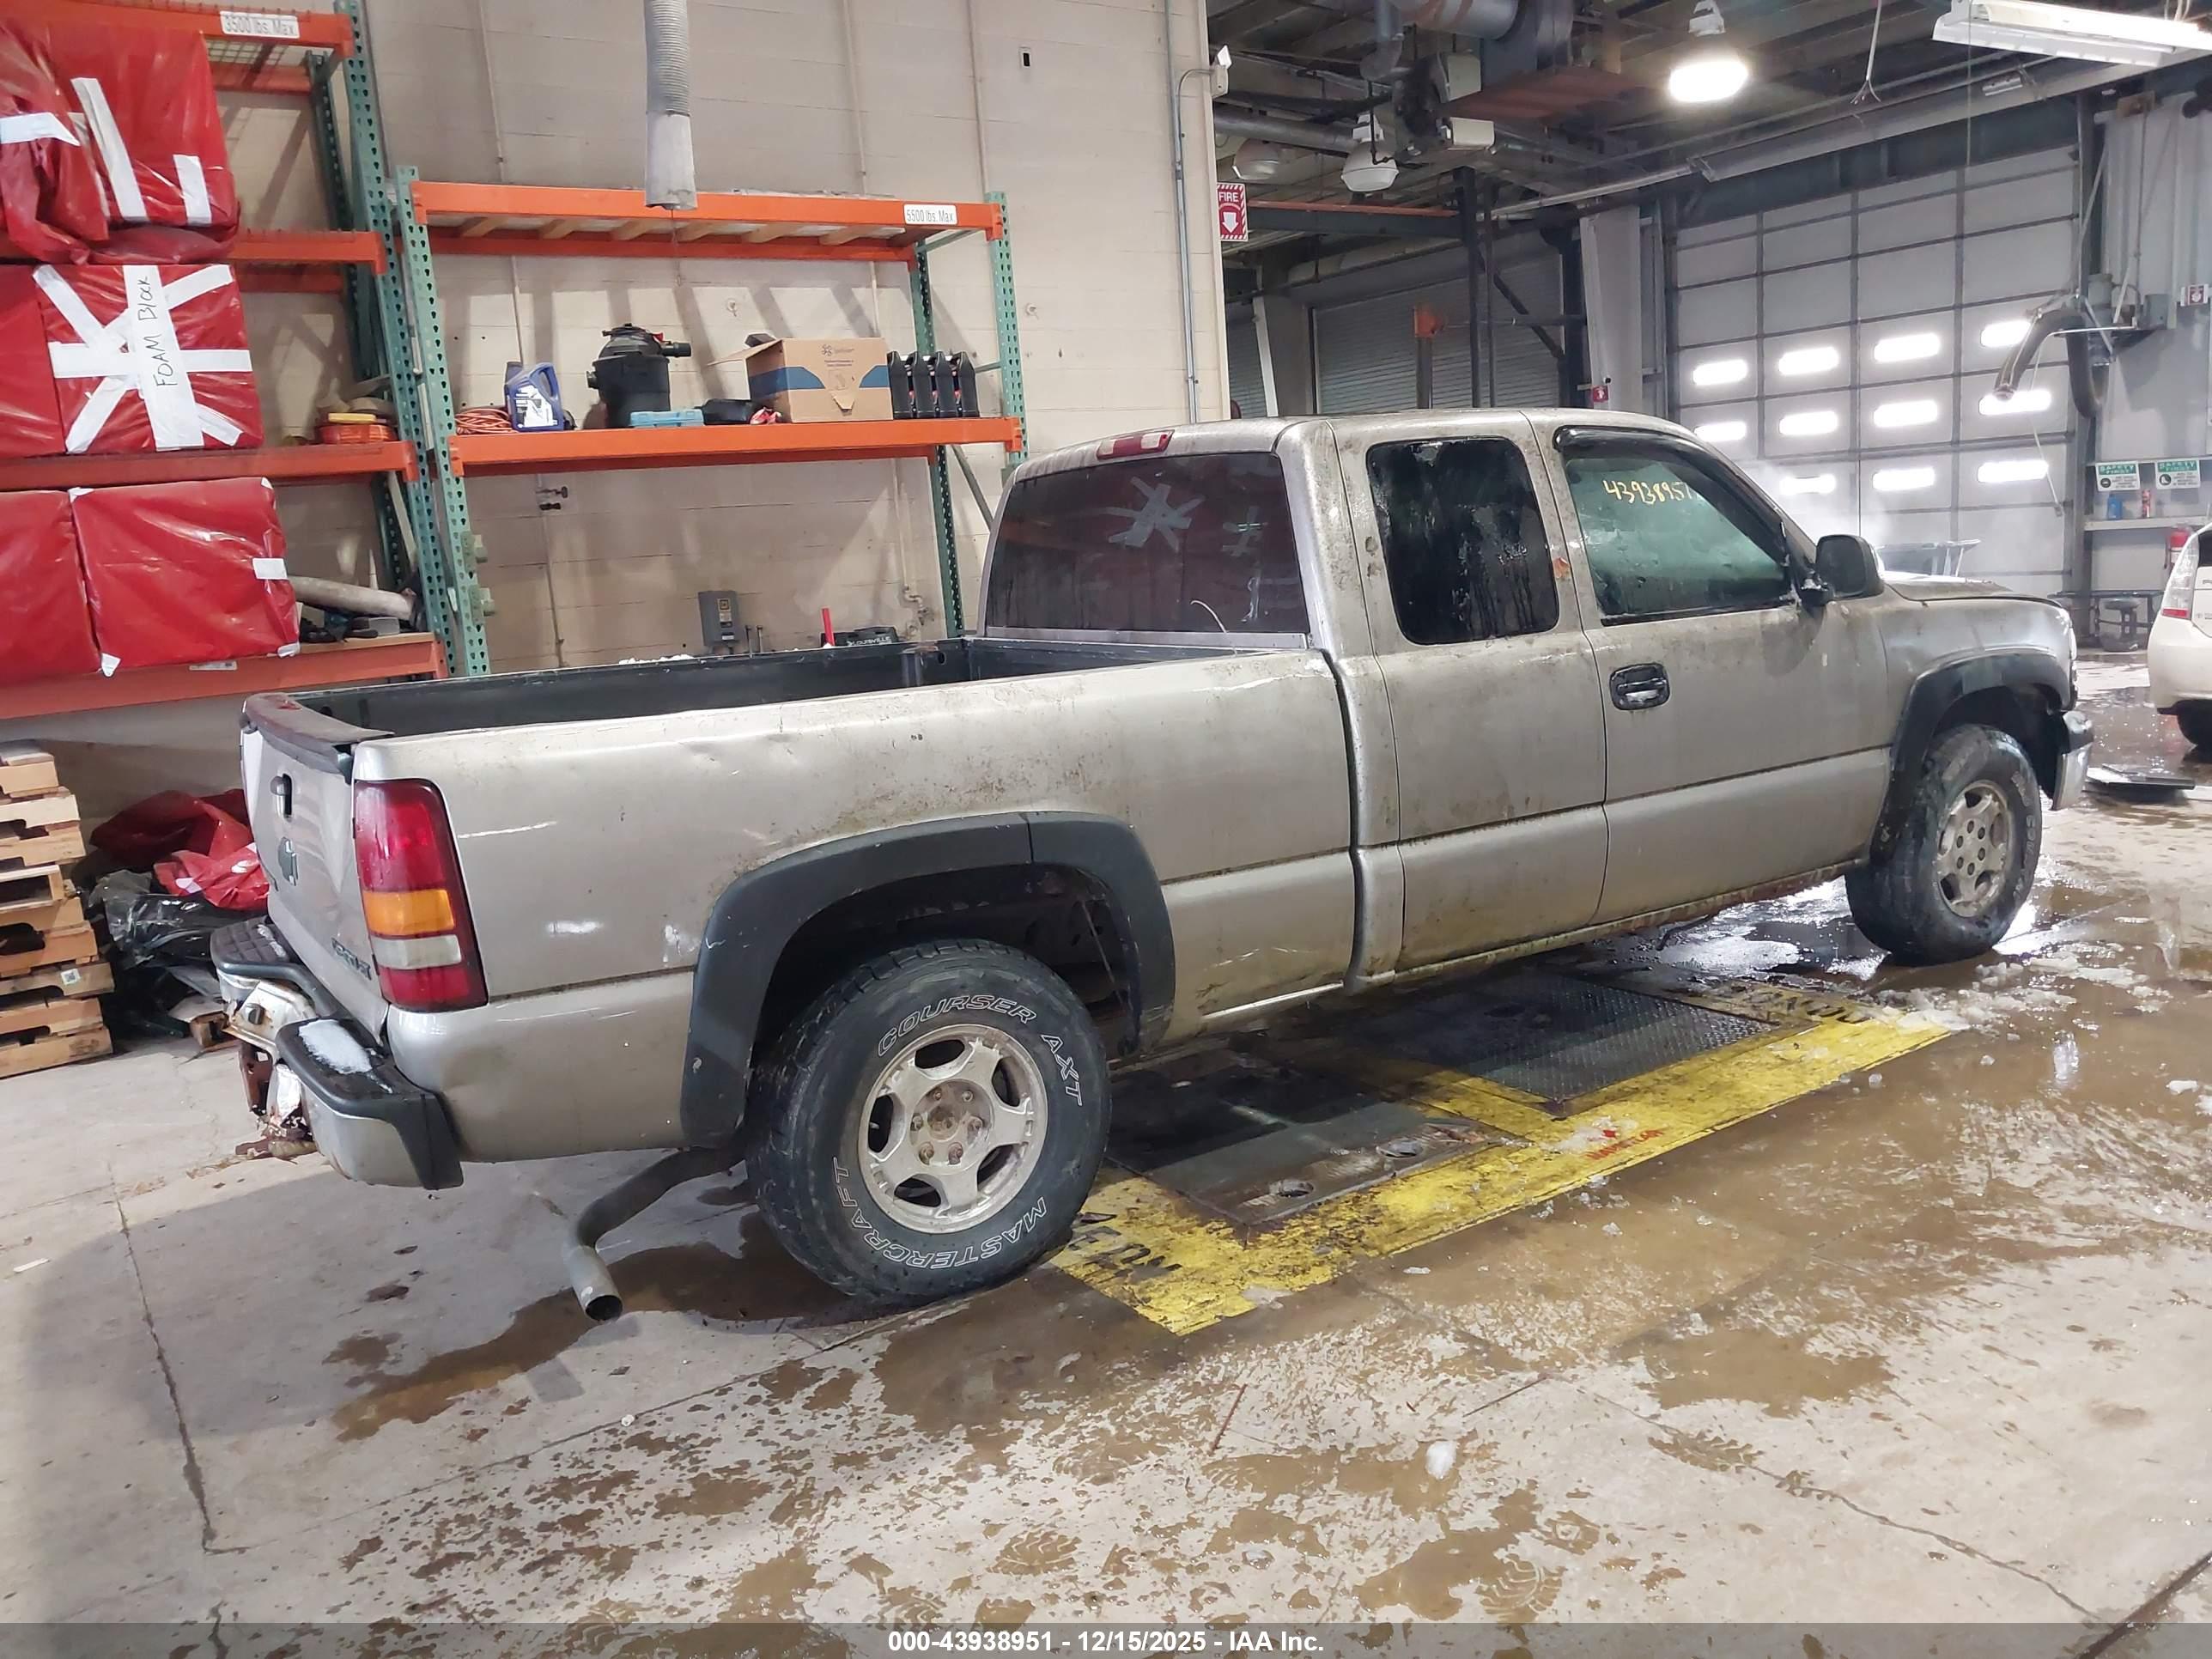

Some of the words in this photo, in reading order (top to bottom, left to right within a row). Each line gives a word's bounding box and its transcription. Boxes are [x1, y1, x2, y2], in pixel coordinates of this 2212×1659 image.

[906, 209, 924, 222] 5500
[1219, 191, 1239, 203] FIRE
[143, 334, 178, 386] FOAM
[878, 994, 1037, 1057] COURSER
[1040, 1034, 1083, 1107] AXT
[833, 1156, 1048, 1270] MASTERCRAFT
